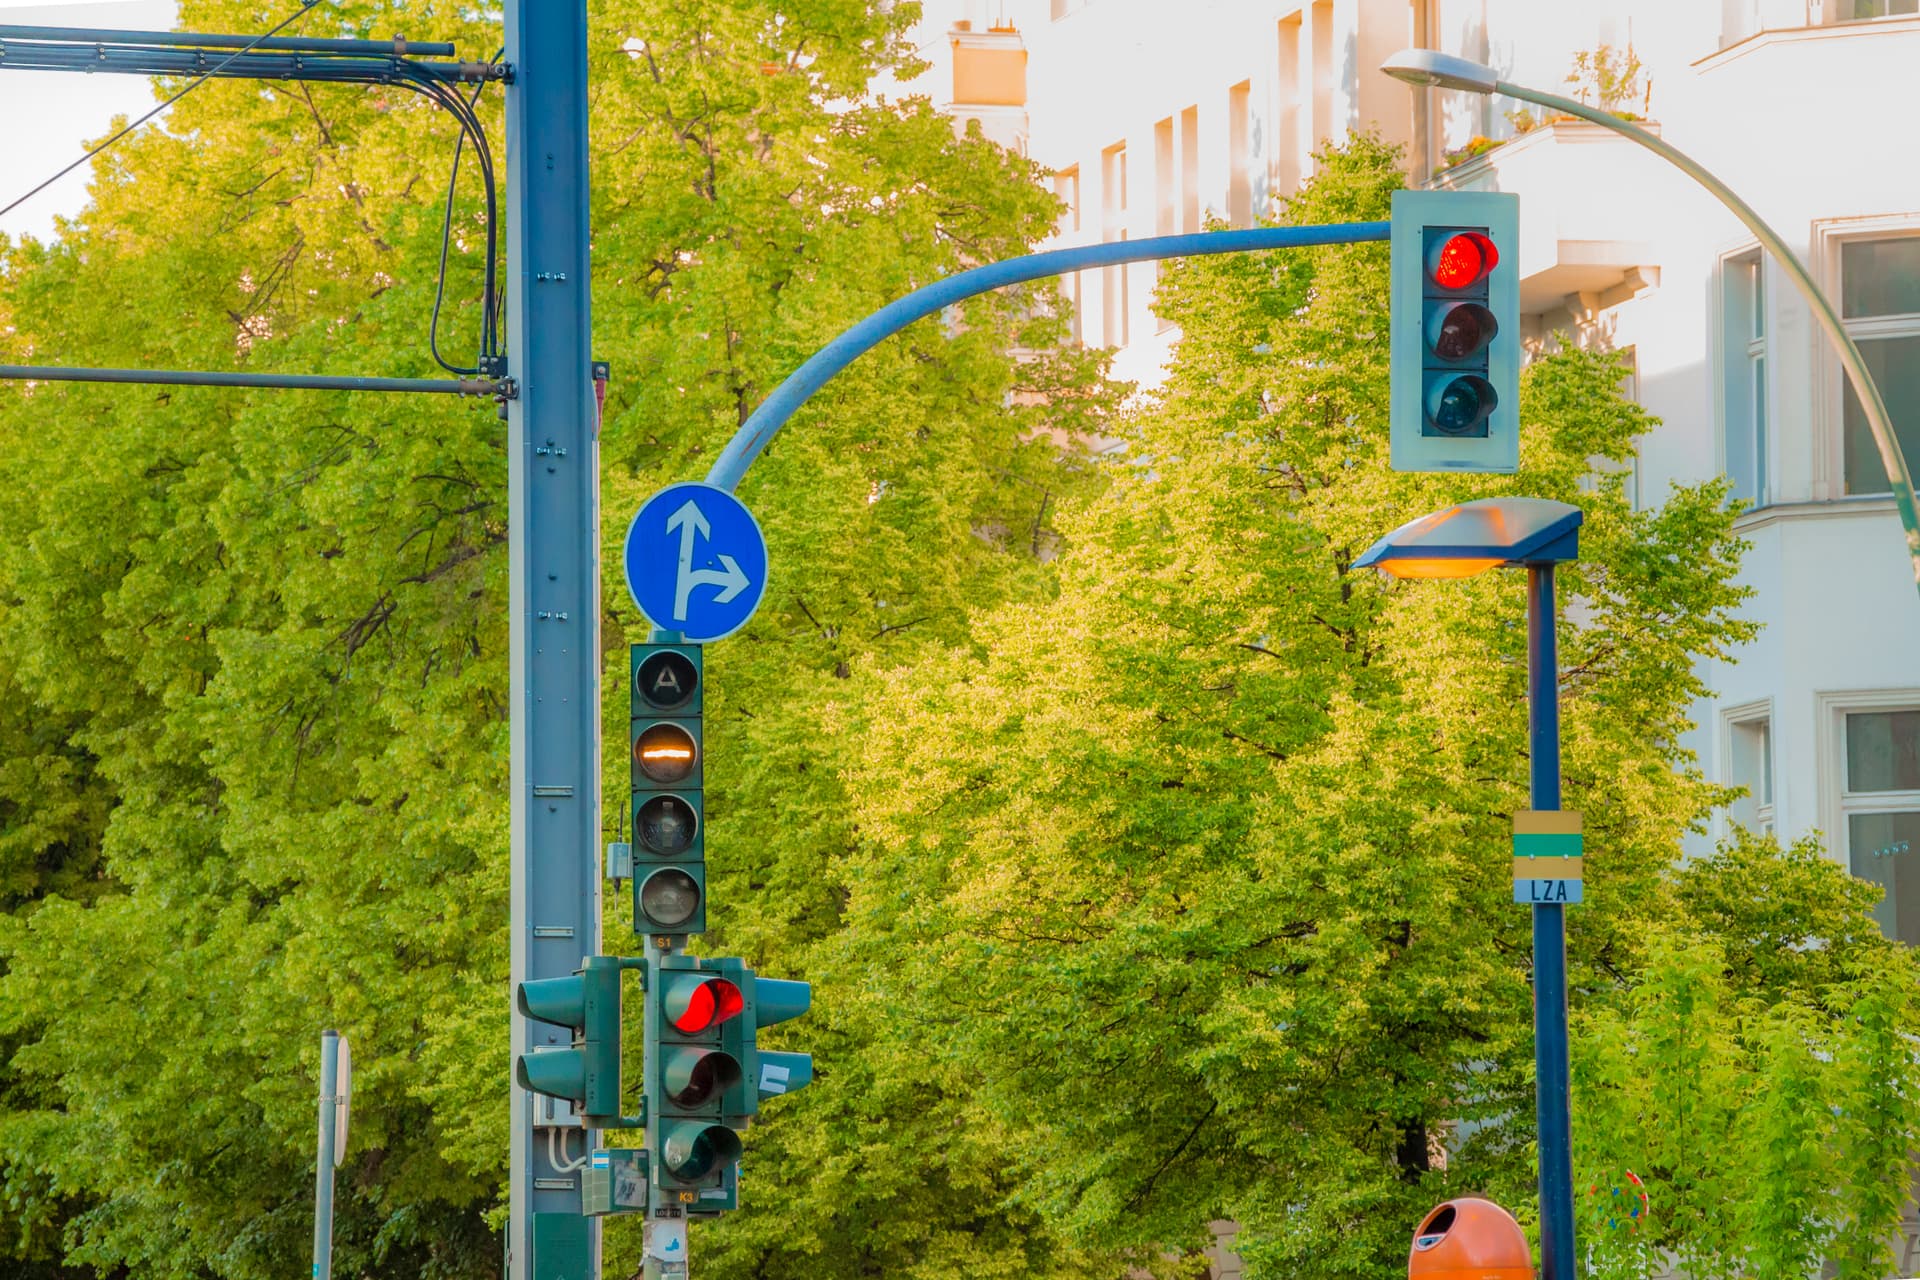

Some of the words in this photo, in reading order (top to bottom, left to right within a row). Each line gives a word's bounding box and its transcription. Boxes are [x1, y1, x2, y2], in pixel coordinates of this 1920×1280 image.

[653, 665, 682, 693] A
[1531, 880, 1568, 901] LZA
[657, 937, 671, 948] S1
[680, 1192, 694, 1203] K3
